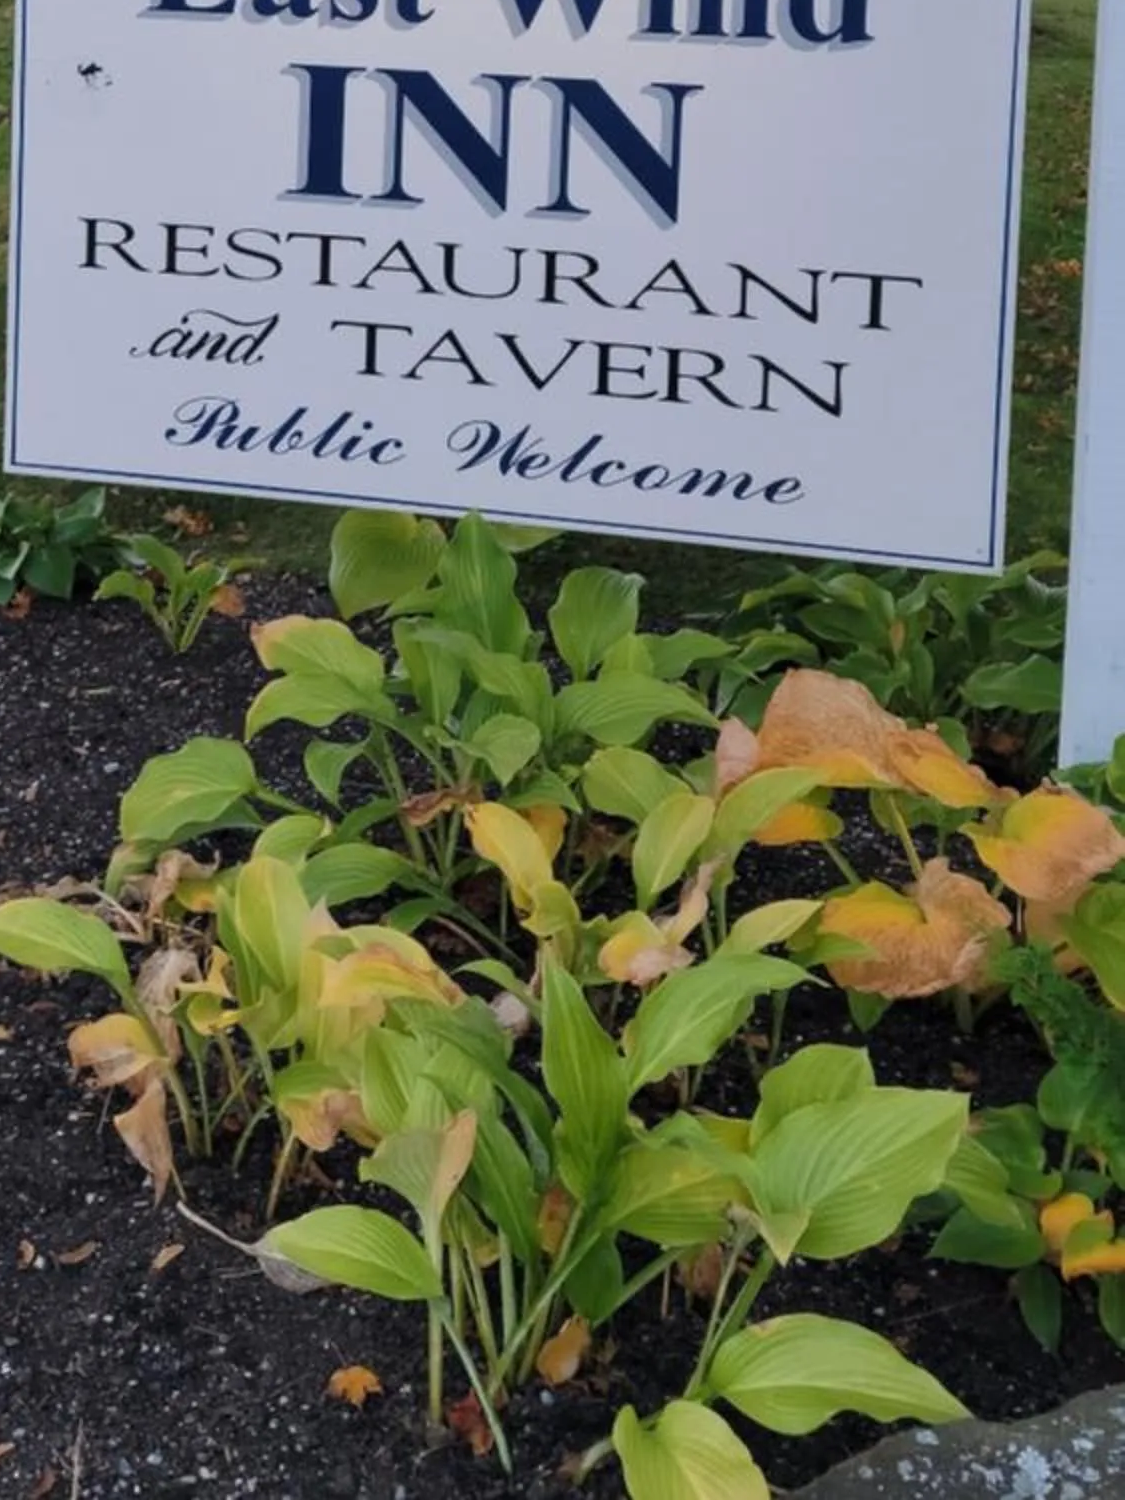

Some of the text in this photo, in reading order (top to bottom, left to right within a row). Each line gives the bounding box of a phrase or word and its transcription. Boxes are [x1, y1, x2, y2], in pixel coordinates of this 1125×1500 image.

[279, 63, 705, 227] INN
[78, 216, 925, 332] RESTAURANT
[129, 307, 851, 419] and TAVERN
[164, 395, 805, 506] Public Welcome
